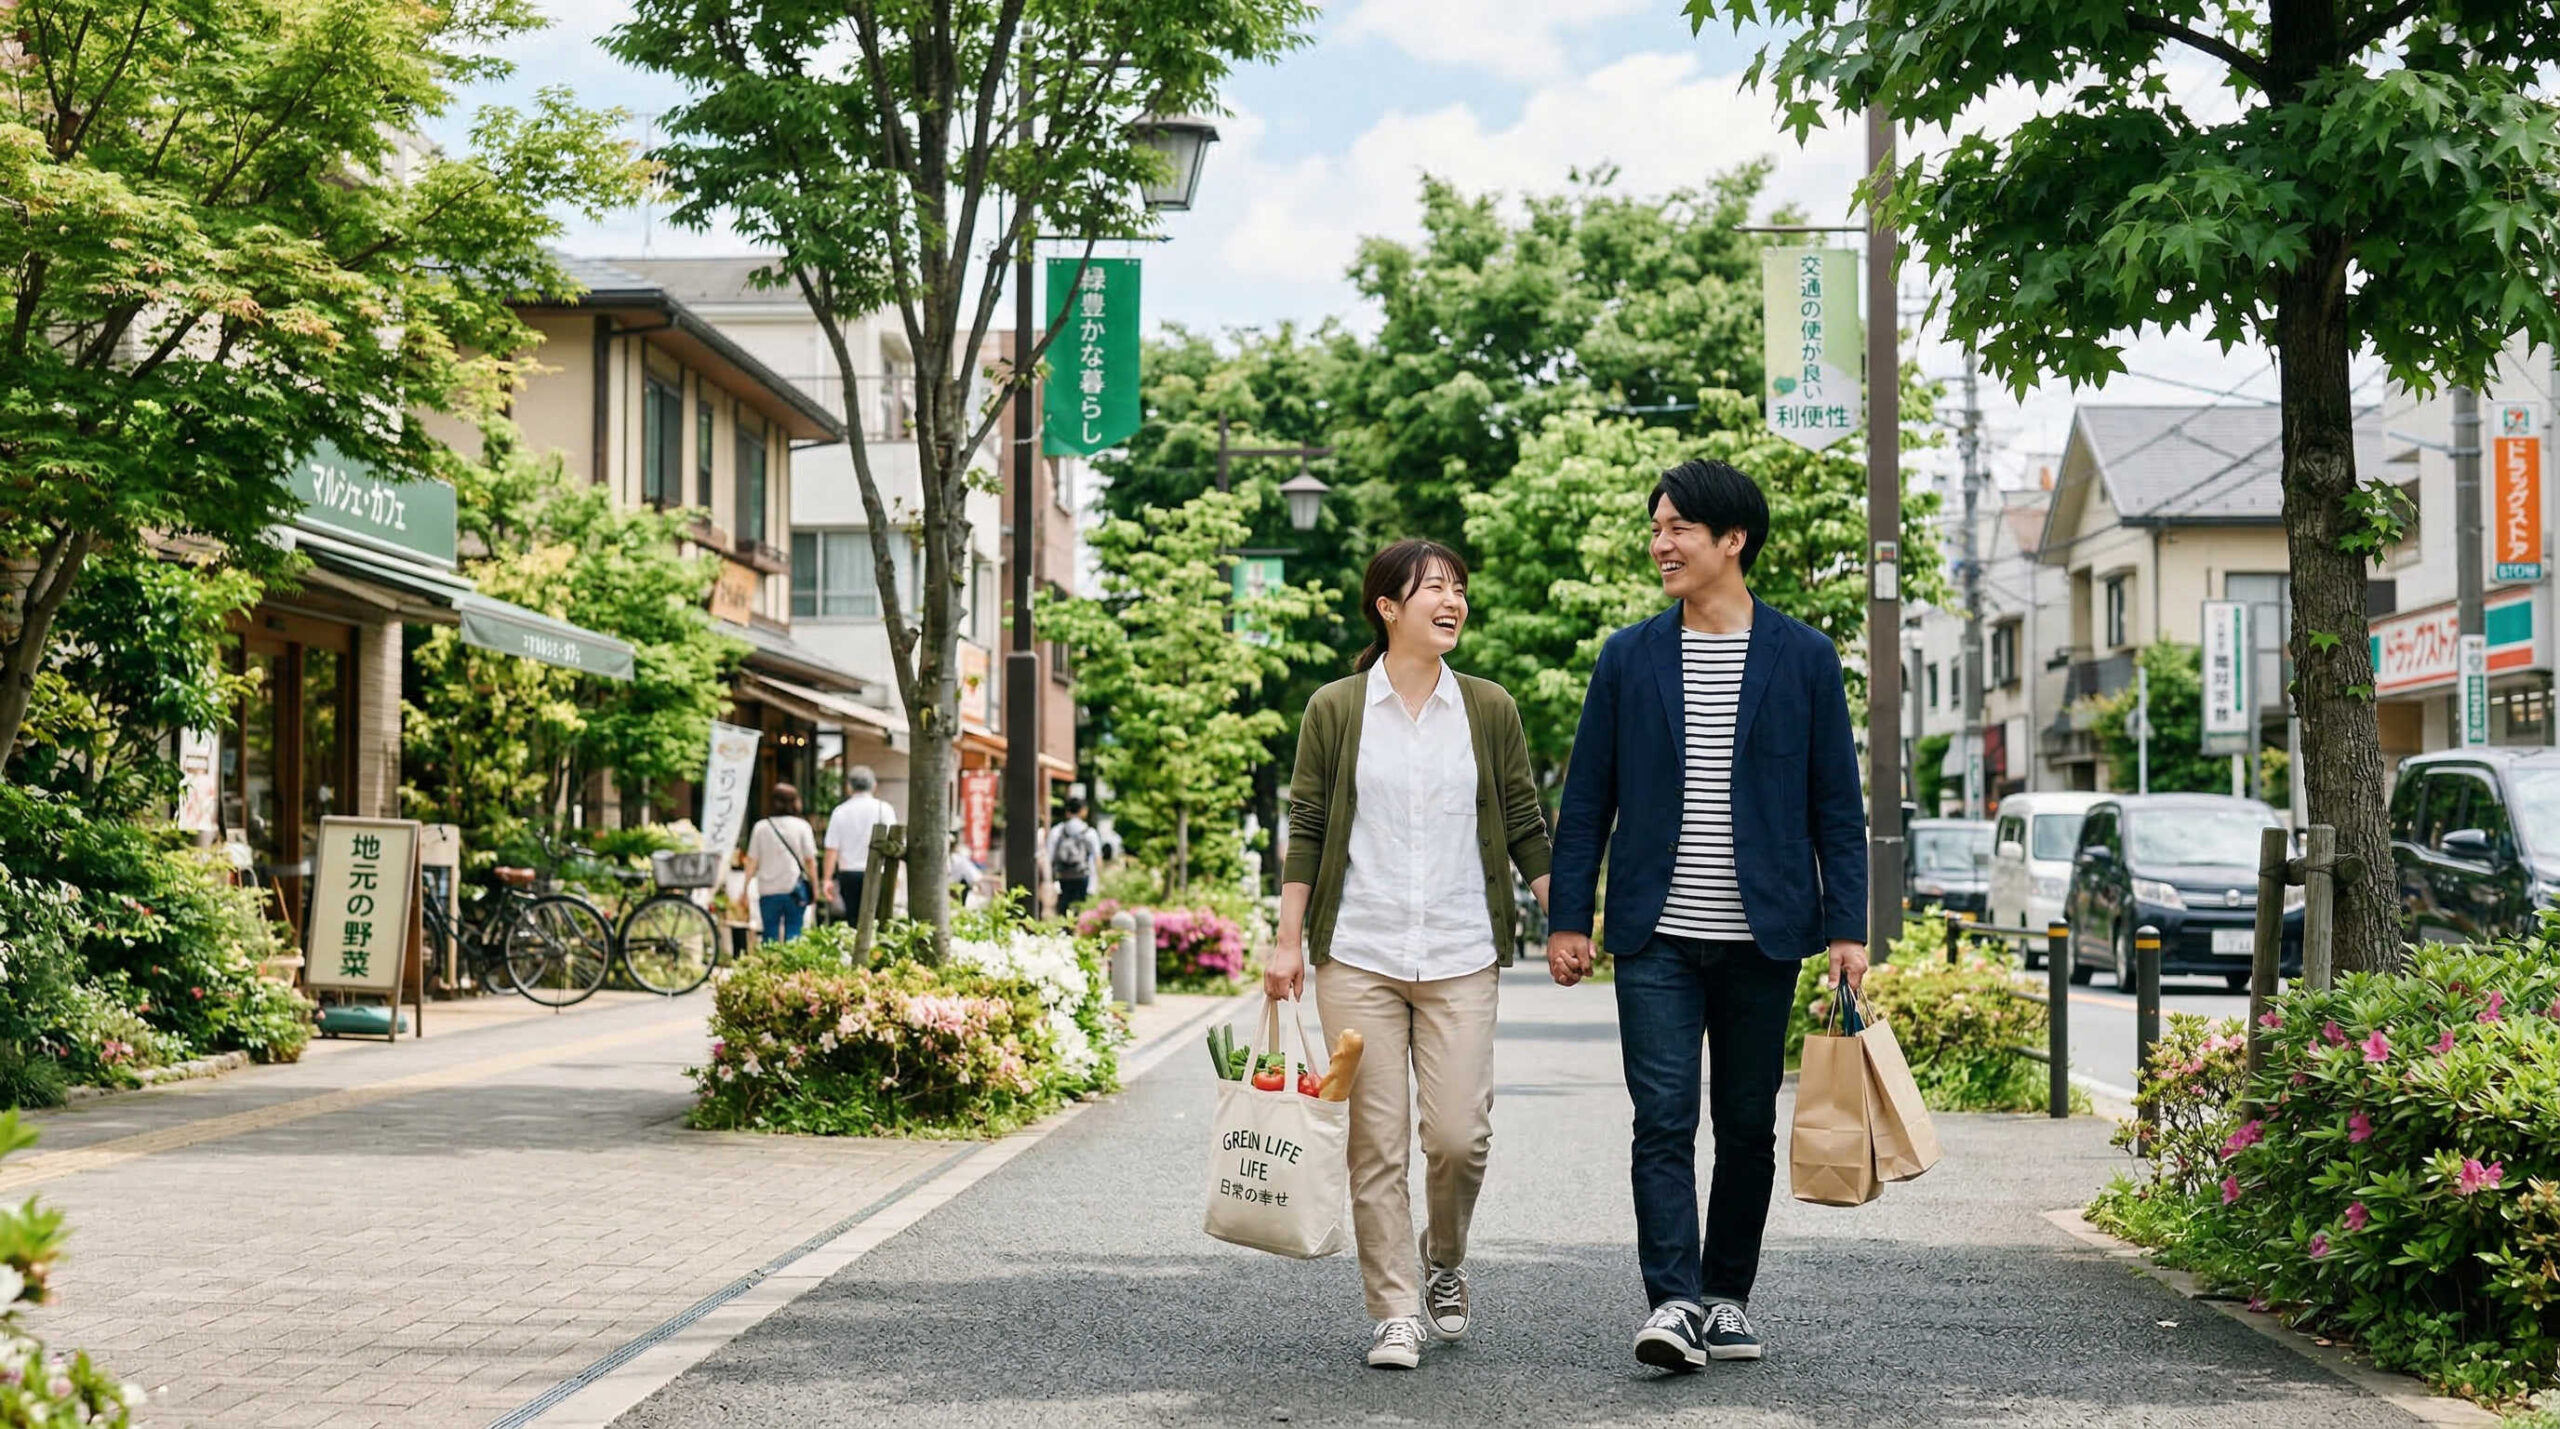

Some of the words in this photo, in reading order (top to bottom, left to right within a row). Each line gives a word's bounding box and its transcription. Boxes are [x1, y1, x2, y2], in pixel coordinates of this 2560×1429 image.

[1801, 255, 1822, 399] 交通の便が良い
[1080, 266, 1106, 444] 緑豊かな暮らし
[1775, 404, 1850, 429] 利便性
[311, 463, 406, 531] マルシェ・カフェ
[340, 832, 380, 978] 地元の野菜
[1239, 1158, 1268, 1181] LIFE
[1265, 1136, 1303, 1165] LIFE
[1220, 1178, 1289, 1207] 日常の幸せ
